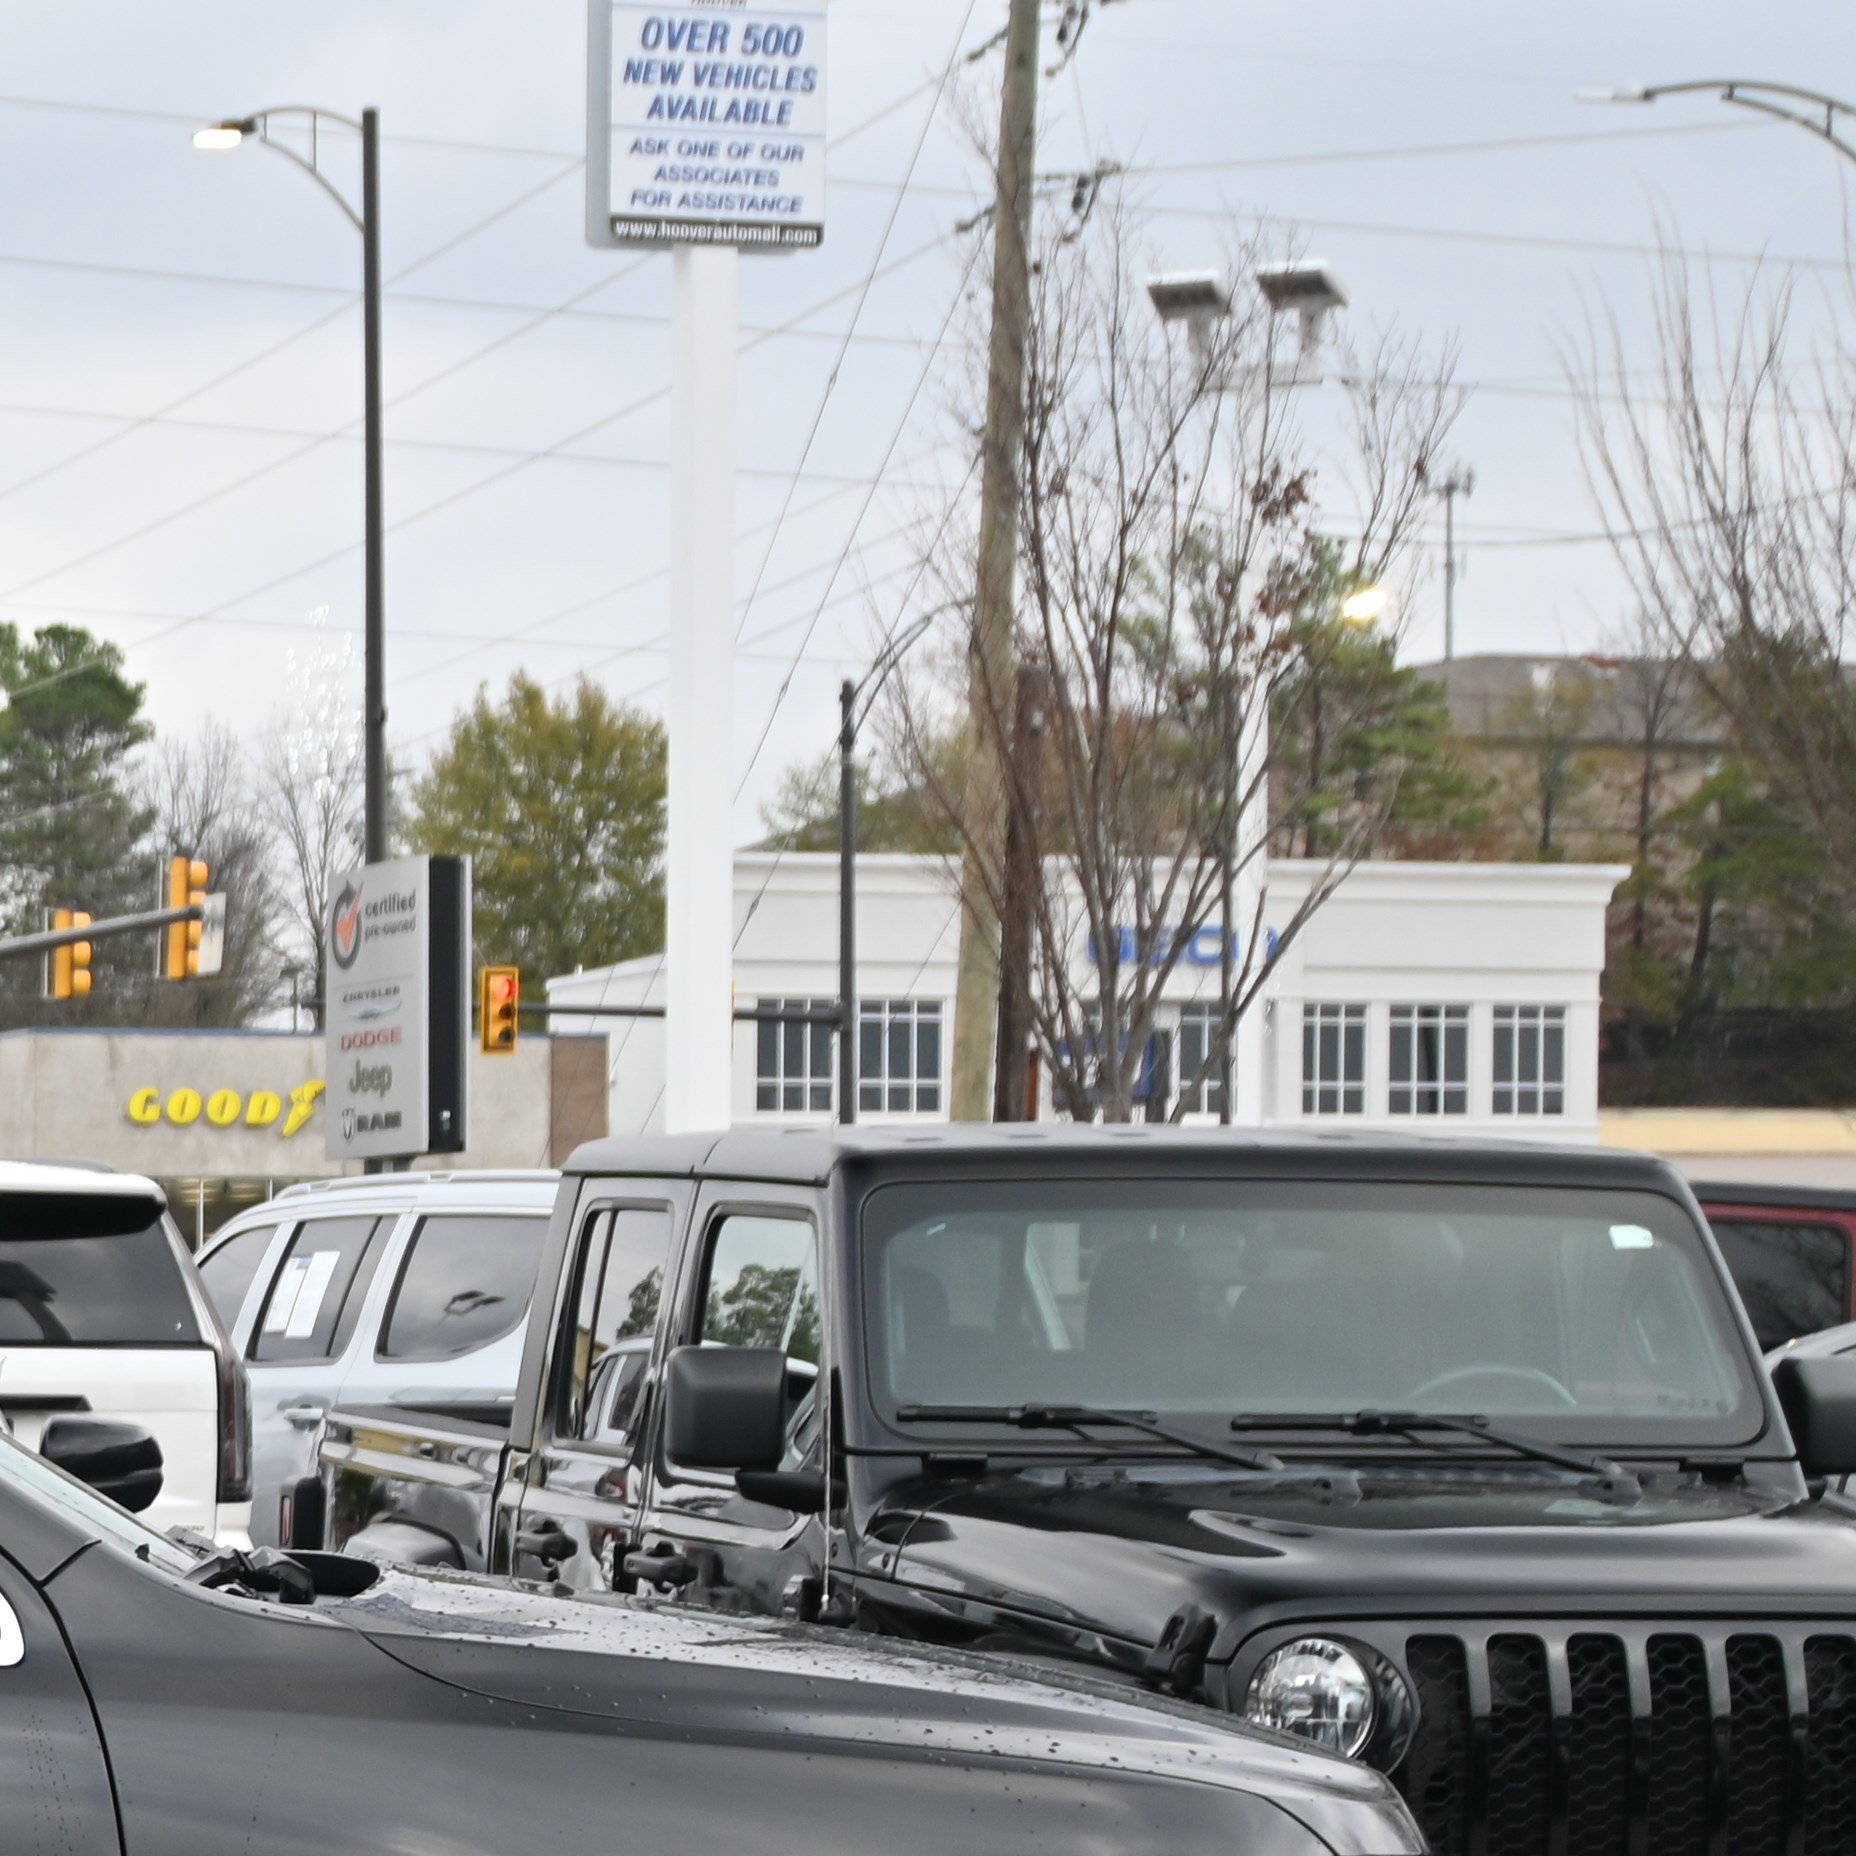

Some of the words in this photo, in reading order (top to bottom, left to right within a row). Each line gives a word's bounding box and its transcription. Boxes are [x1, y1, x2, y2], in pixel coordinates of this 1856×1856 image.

[641, 17, 731, 54] OVER
[741, 23, 805, 58] 500
[623, 57, 684, 86] NEW
[693, 61, 818, 93] VEHICLES
[647, 94, 793, 126] AVAILABLE
[629, 137, 670, 156] ASK
[677, 140, 720, 159] ONE
[727, 142, 754, 161] OF
[760, 143, 805, 162] OUR
[653, 164, 780, 187] ASSOCIATES
[630, 189, 672, 208] FOR
[678, 191, 803, 213] ASSISTANCE
[615, 220, 818, 245] www.hooverautomall.com
[365, 888, 416, 918] certified
[365, 914, 416, 942] pre-owned
[341, 1026, 402, 1051] DODGE
[350, 1059, 393, 1097] Jeep
[357, 1110, 403, 1132] RAM
